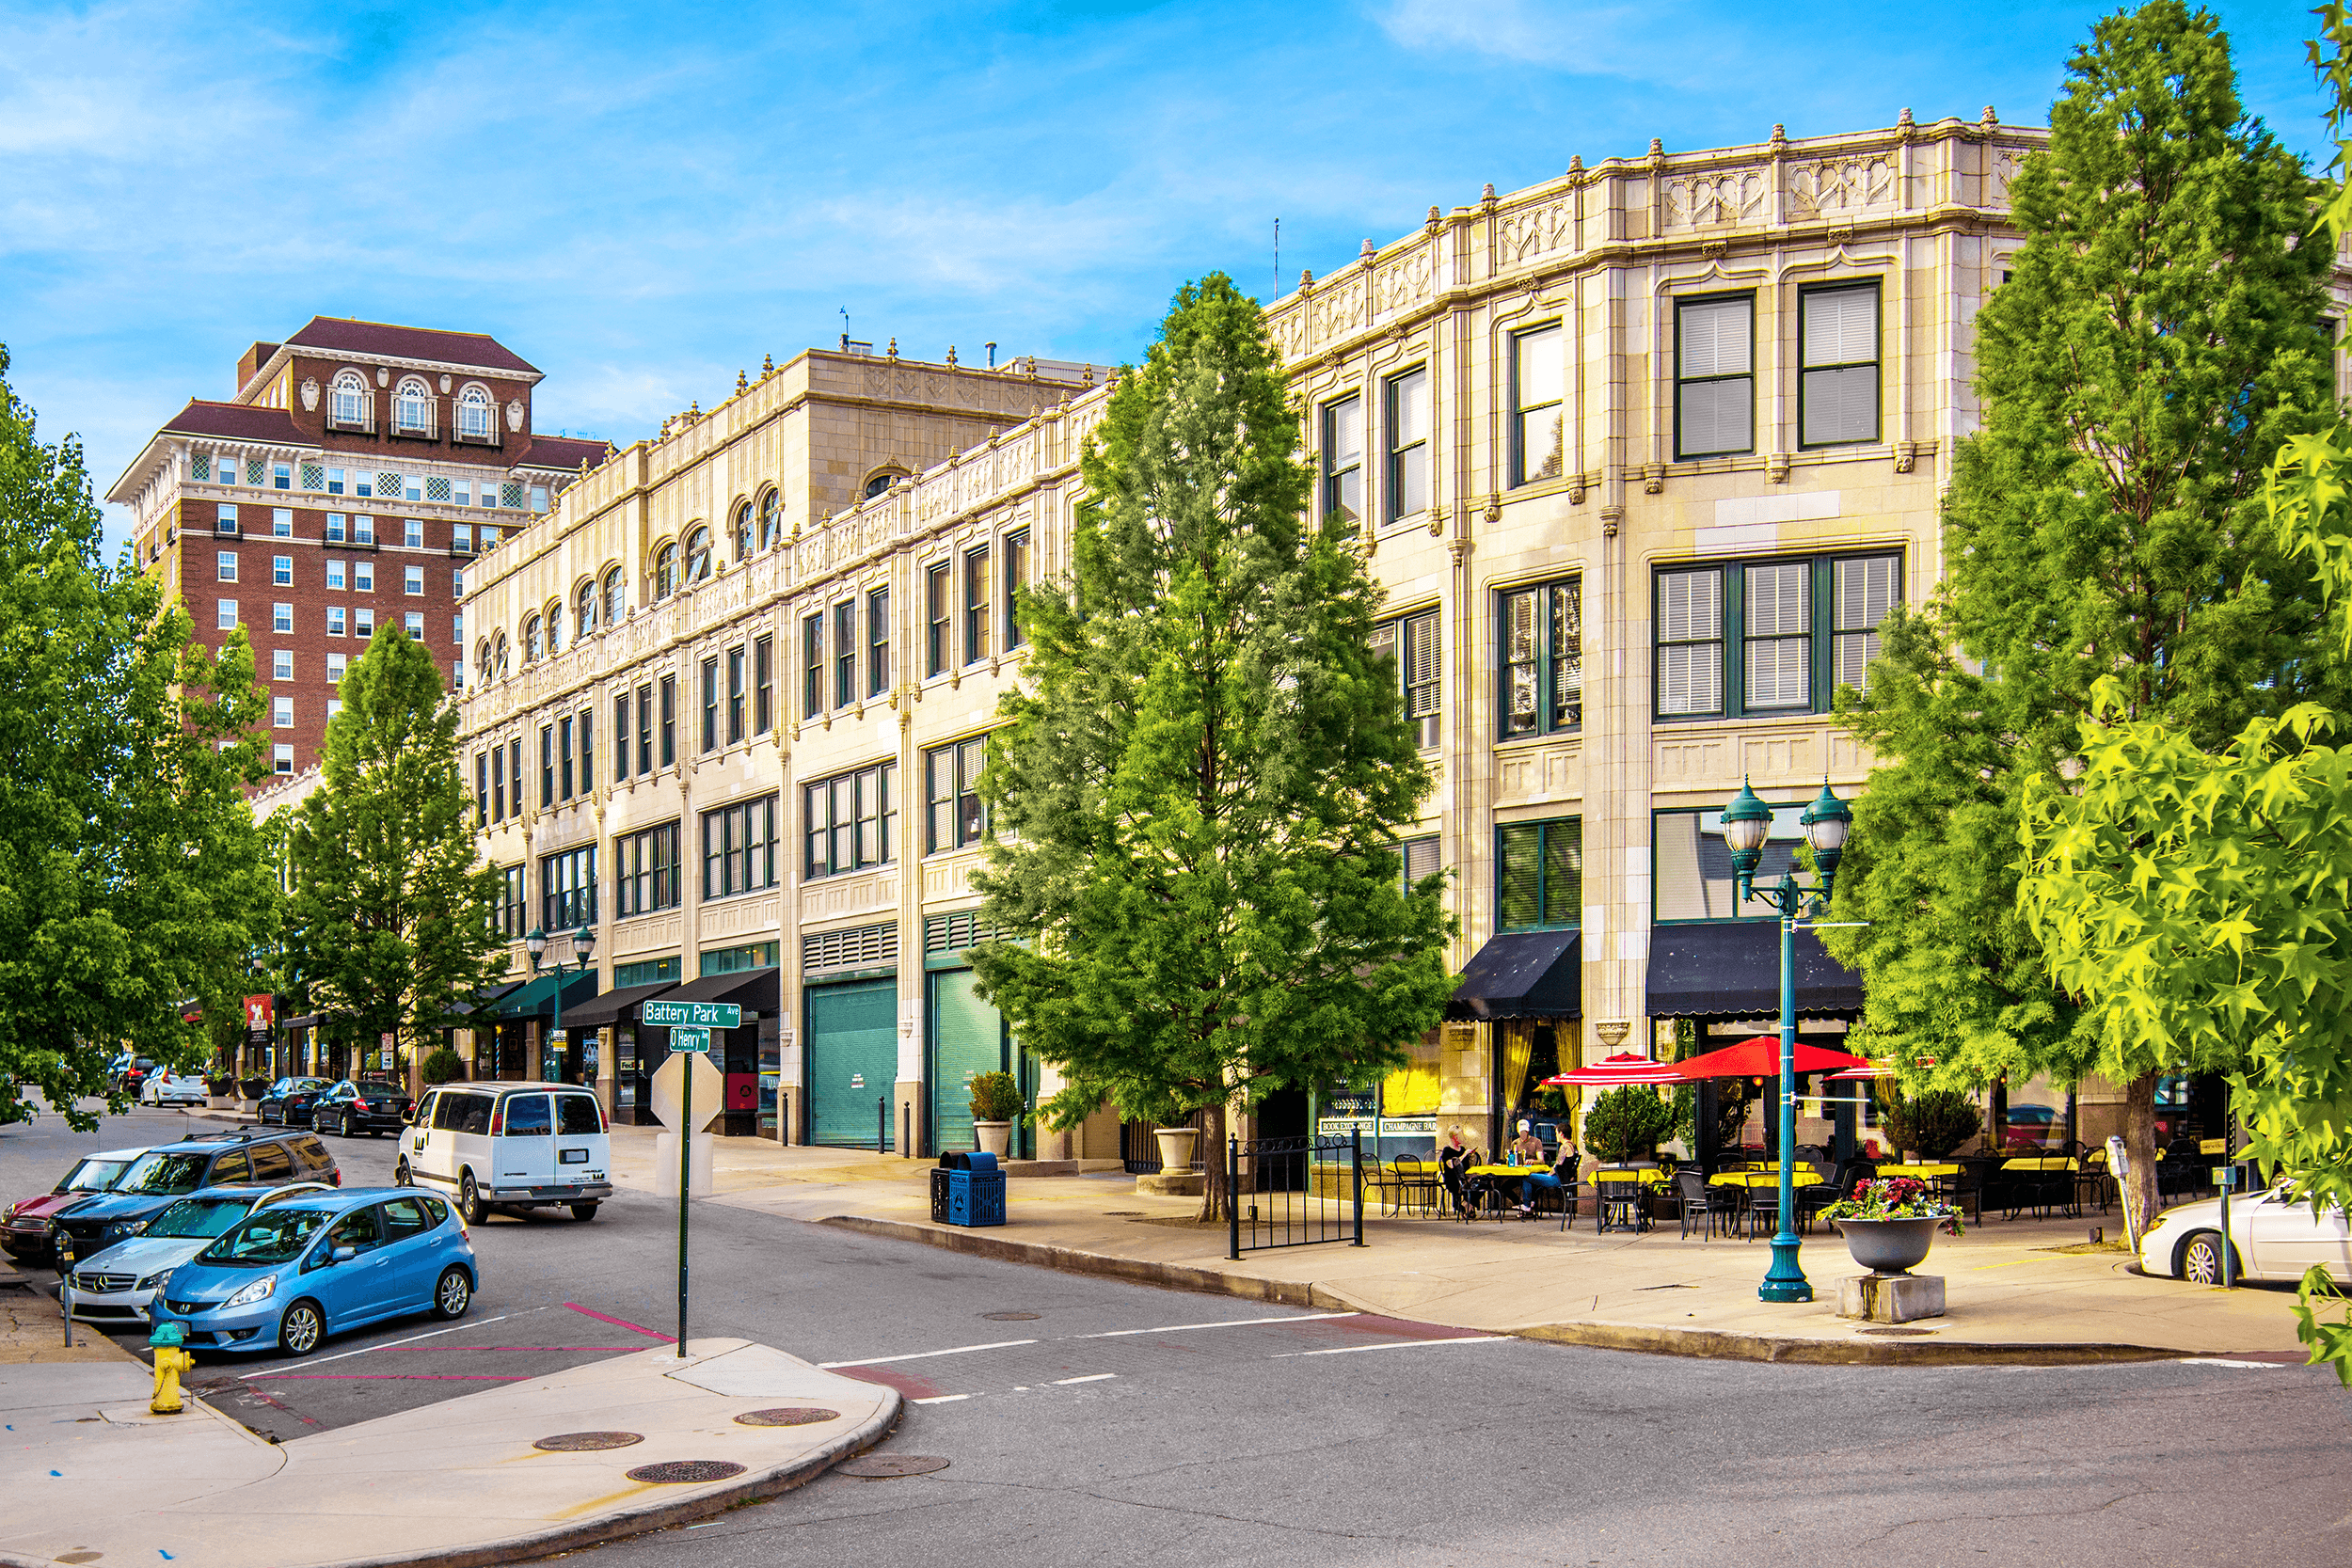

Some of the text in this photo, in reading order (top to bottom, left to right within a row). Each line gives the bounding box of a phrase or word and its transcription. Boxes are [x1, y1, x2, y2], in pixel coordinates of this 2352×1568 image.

[645, 1003, 739, 1024] Battery Park Ave
[671, 1029, 676, 1046] O
[677, 1029, 700, 1051] Henry
[1323, 1122, 1339, 1131] BOOK
[1384, 1122, 1437, 1131] CHAMPAGNE BAR
